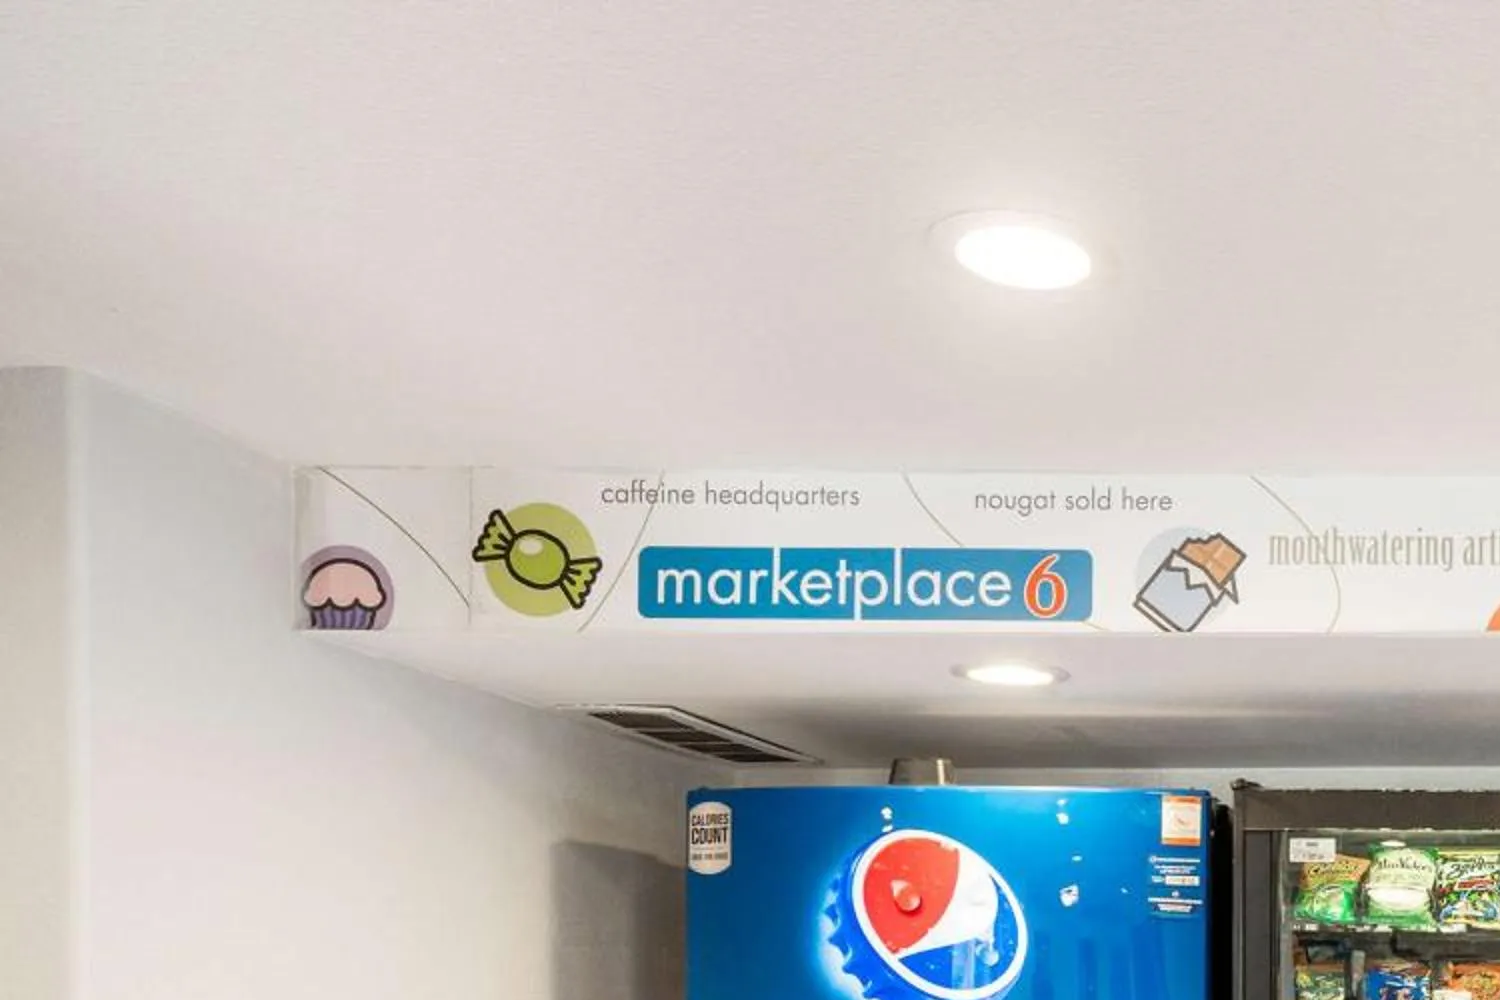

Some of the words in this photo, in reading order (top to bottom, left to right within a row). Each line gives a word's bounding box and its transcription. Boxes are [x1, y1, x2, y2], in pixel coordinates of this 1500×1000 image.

[601, 480, 695, 505] caffeine
[705, 483, 860, 508] headquarters
[975, 492, 1056, 516] nougat
[1065, 486, 1111, 510] sold
[1122, 487, 1172, 510] here
[1269, 527, 1453, 571] mouthwatering
[657, 548, 1011, 619] marketplace
[691, 827, 729, 844] COUNT
